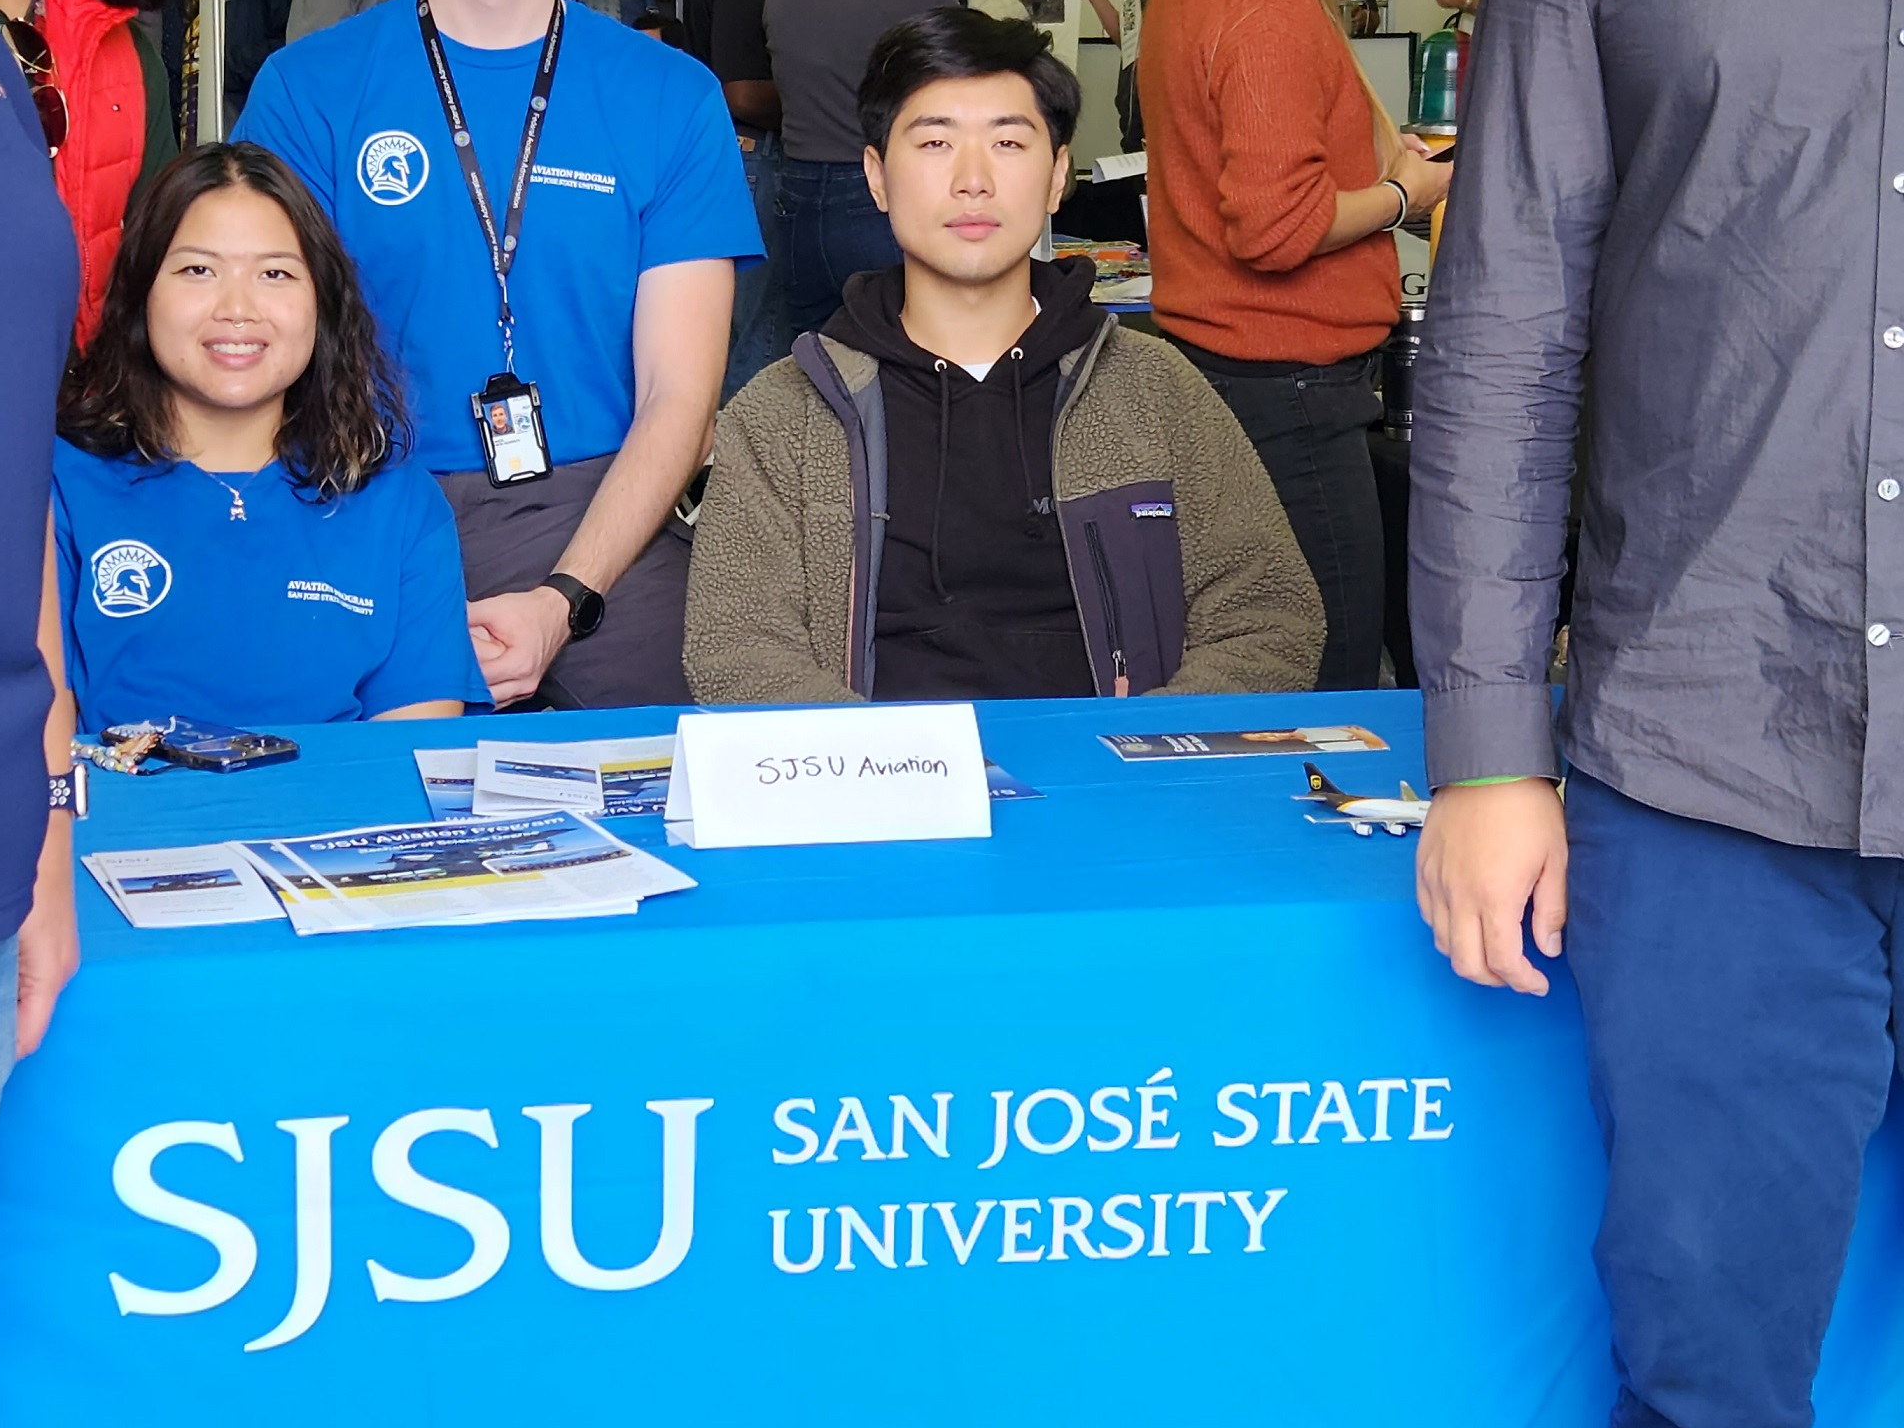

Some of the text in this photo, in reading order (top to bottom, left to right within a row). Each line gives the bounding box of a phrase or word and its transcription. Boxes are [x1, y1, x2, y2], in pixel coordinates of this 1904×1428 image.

[532, 165, 616, 186] AVIATION PROGRAM
[288, 580, 333, 594] AVIATION
[858, 755, 947, 778] Aviation
[375, 828, 466, 844] Aviation
[470, 816, 565, 834] Program
[108, 1067, 1454, 1352] SJSU SAN JOSÉ STATE
[768, 1188, 1288, 1274] UNIVERSITY
